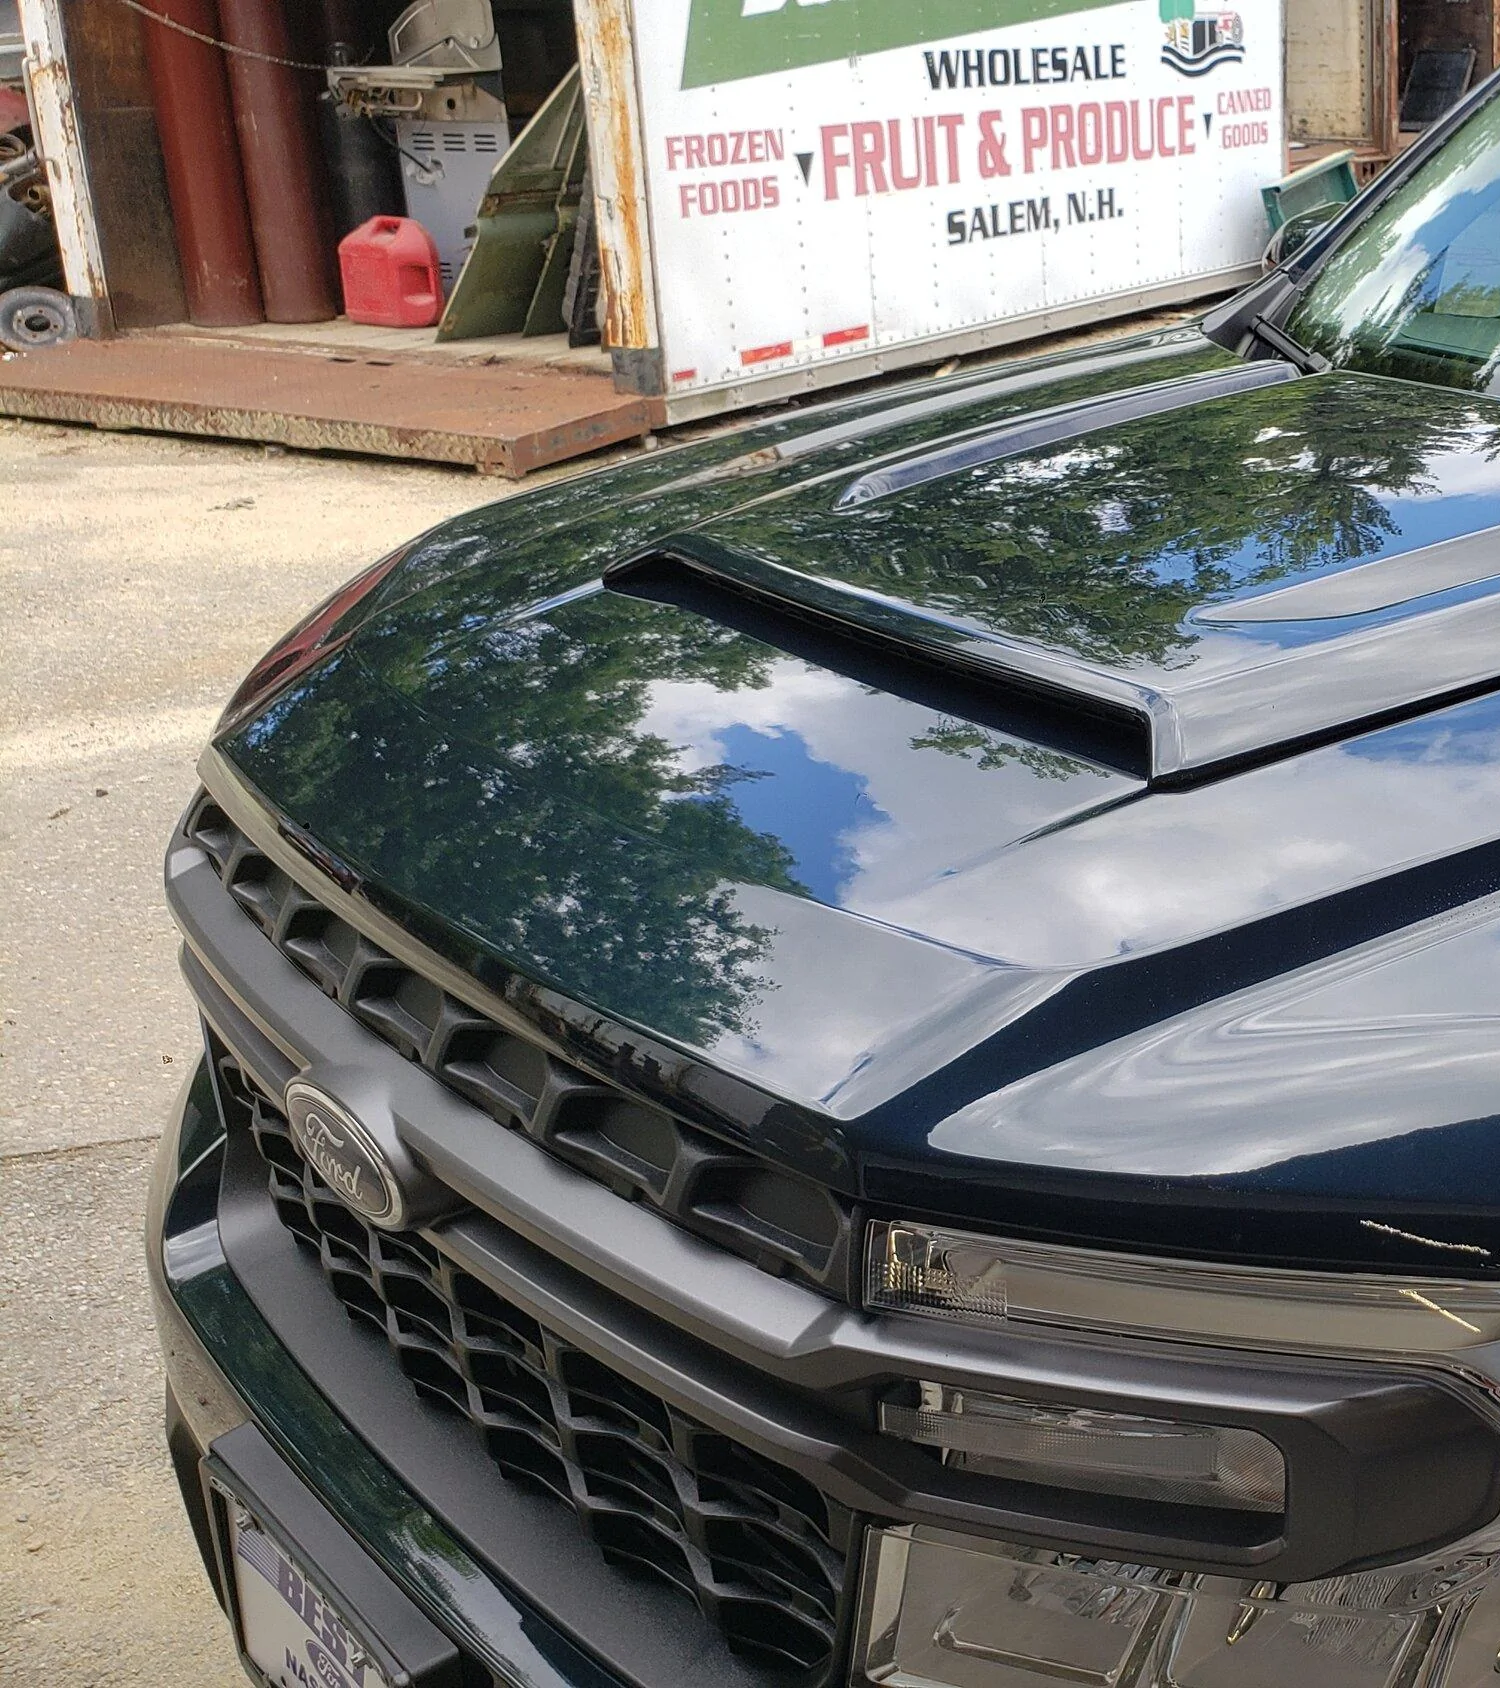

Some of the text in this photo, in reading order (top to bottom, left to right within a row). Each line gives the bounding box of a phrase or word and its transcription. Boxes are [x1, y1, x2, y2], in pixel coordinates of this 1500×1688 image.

[923, 44, 1127, 90] WHOLESALE
[1217, 88, 1271, 115] CANNED
[665, 128, 785, 171] FROZEN
[819, 95, 1196, 201] FRUIT & PRODUCE
[1222, 121, 1269, 149] GOODS
[679, 175, 781, 219] FOODS
[947, 187, 1124, 246] SALEM, N.H.
[303, 1112, 363, 1200] Ford
